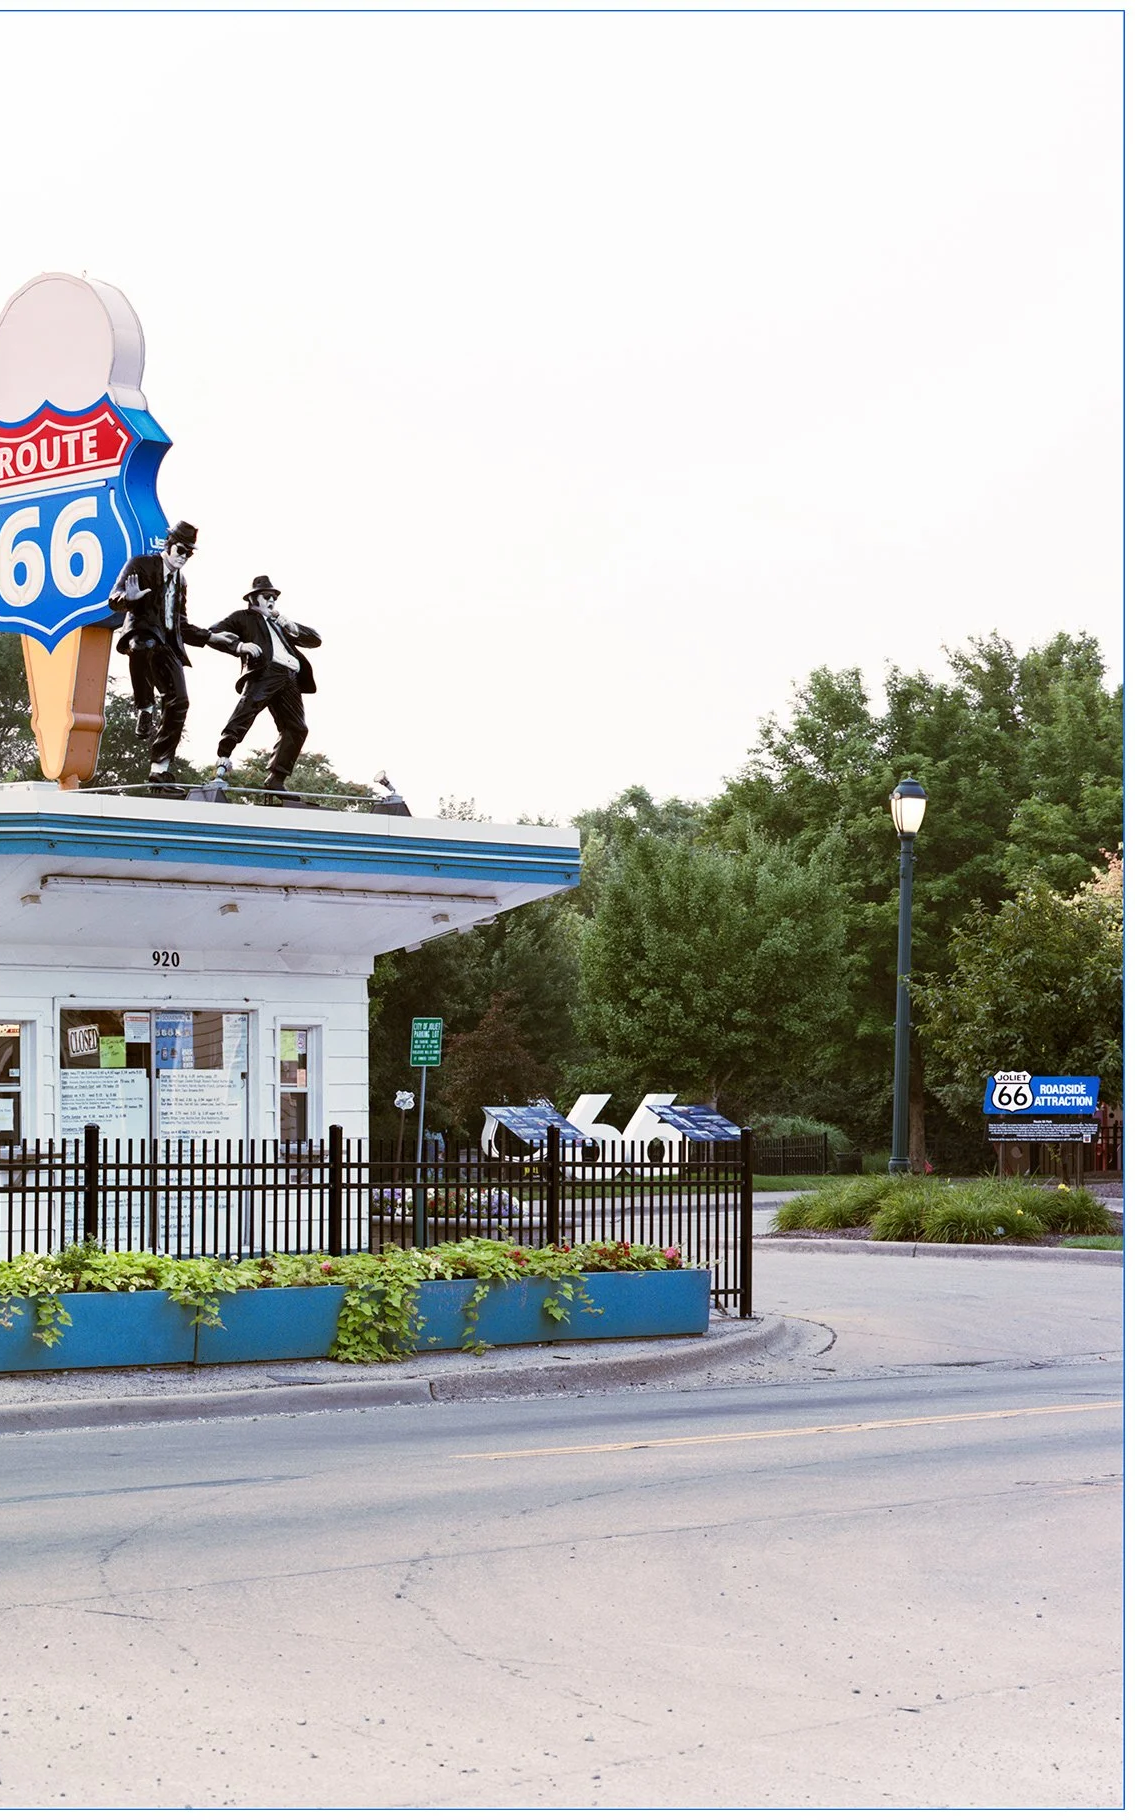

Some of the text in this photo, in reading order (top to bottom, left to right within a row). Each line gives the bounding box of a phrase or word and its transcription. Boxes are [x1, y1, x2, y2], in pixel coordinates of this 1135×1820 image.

[152, 951, 180, 967] 920
[70, 1028, 98, 1053] CLOSED
[998, 1086, 1027, 1106] 66
[1039, 1084, 1086, 1094] ROADSIDE
[1034, 1096, 1092, 1106] ATTRACTION
[559, 1094, 688, 1179] 66
